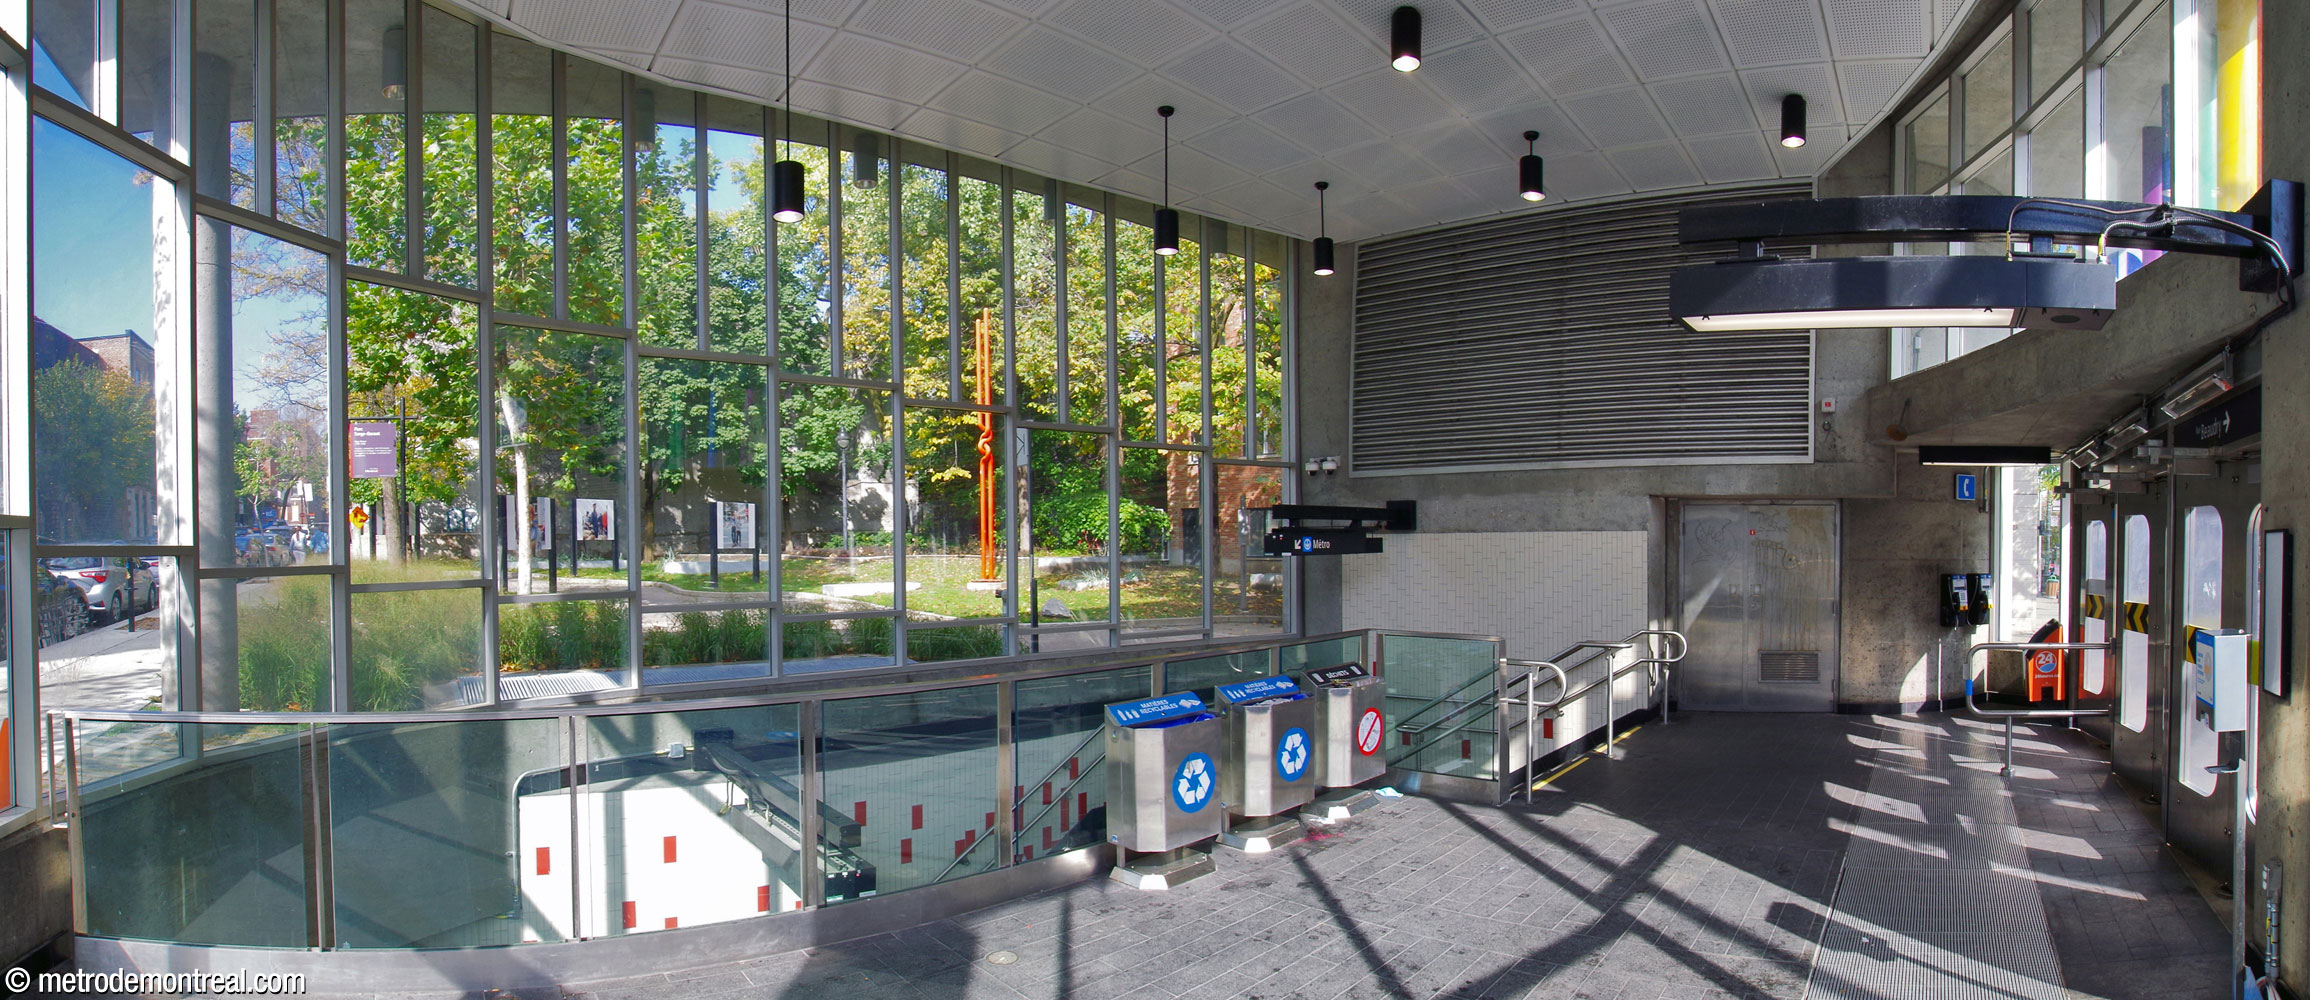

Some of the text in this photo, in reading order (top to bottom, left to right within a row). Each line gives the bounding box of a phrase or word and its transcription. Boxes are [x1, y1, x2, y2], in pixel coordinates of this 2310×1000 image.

[1313, 539, 1331, 549] Métro
[2037, 653, 2055, 665] 24
[1326, 670, 1350, 679] DÉCHETS
[1245, 684, 1277, 694] RECYCLABLES
[1140, 700, 1169, 708] MATIÈRES
[1140, 703, 1179, 714] RECYCLABLES
